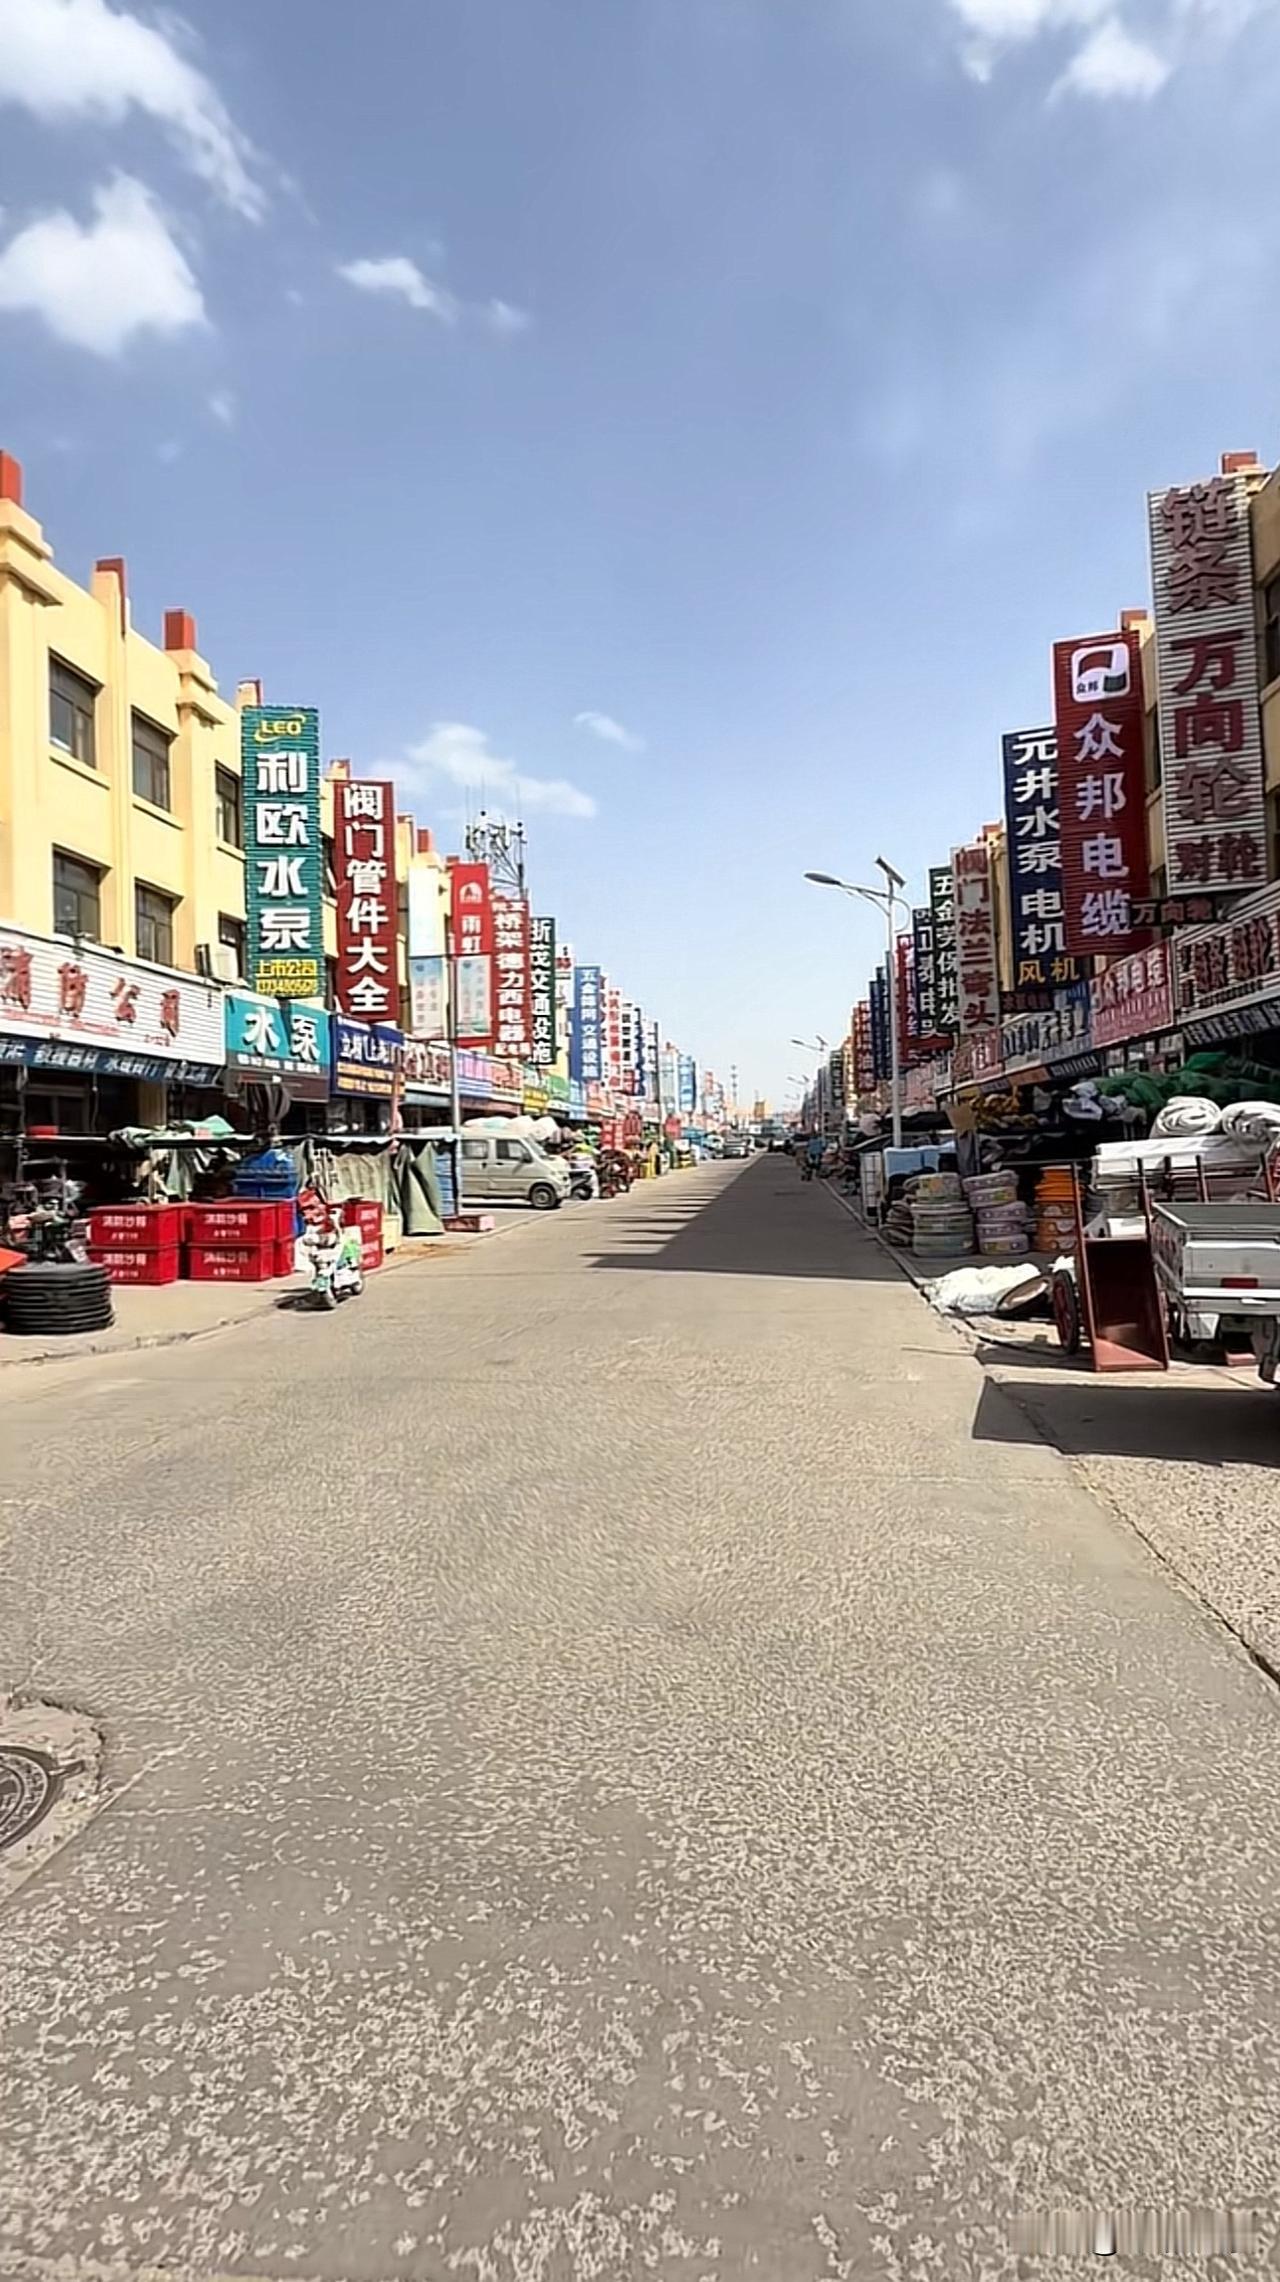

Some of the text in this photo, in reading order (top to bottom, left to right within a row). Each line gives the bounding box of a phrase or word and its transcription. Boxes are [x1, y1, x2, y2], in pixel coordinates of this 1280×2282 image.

[259, 718, 303, 736] LEO
[256, 751, 312, 950] 利欧水泵
[1074, 713, 1132, 937] 众邦电缆
[343, 783, 390, 1014] 阀门管件大全
[462, 915, 481, 953] 雨虹
[956, 849, 997, 1029] 阀门法兰弯头
[256, 959, 317, 976] 上市公司
[1018, 958, 1080, 986] 风机
[243, 1006, 321, 1061] 水泵
